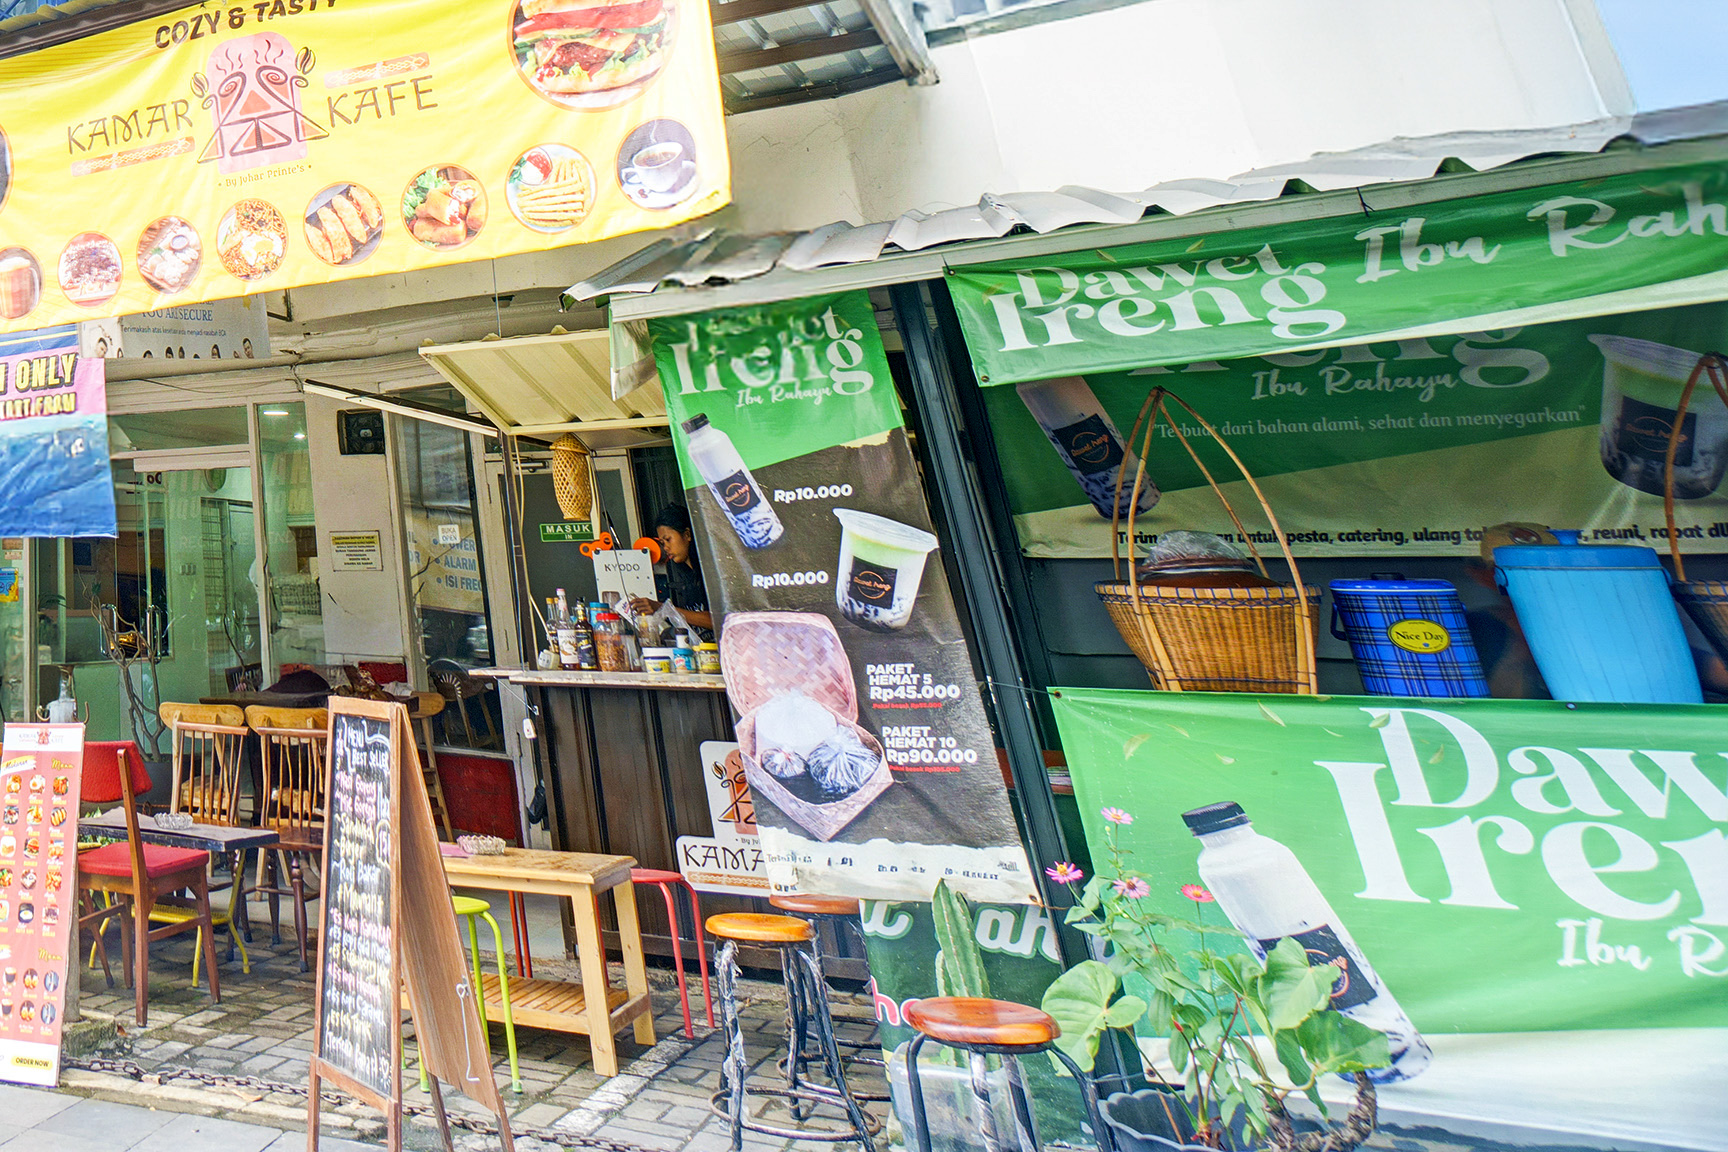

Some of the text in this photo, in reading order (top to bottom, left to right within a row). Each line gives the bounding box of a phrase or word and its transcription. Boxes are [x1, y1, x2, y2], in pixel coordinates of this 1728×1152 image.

[154, 10, 222, 49] COZY
[228, 6, 245, 30] &
[327, 75, 439, 129] KAFE
[67, 99, 194, 155] KAMAR
[226, 179, 237, 187] By
[1354, 216, 1502, 284] Ibu
[1010, 243, 1292, 309] Dawet
[179, 308, 213, 322] SECURE
[986, 262, 1347, 352] Ireng
[15, 352, 79, 393] ONLY
[1250, 362, 1460, 403] Ibu Rahayu
[735, 383, 833, 408] Ibu Rahayu
[1221, 419, 1254, 436] dari
[1257, 417, 1309, 435] bahan
[1312, 414, 1365, 434] alami,
[1368, 413, 1414, 432] sehat
[1419, 411, 1451, 429] dan
[774, 484, 853, 503] Rp10.000
[546, 523, 591, 534] MASUK
[1338, 529, 1409, 547] catering,
[1413, 528, 1460, 546] ulang
[1593, 524, 1646, 541] reuni,
[444, 555, 476, 571] ALARM
[604, 563, 640, 572] KYODO
[445, 575, 459, 588] ISI
[752, 571, 829, 589] Rp10.000
[1395, 631, 1444, 643] Nice Day
[866, 663, 915, 675] PAKET
[869, 674, 932, 685] HEMAT 5
[870, 684, 961, 701] Rp45.000
[347, 725, 364, 749] MENU
[882, 726, 931, 737] PAKET
[885, 736, 957, 748] HEMAT 10
[352, 748, 367, 766] BEST
[886, 749, 978, 765] Rp90.000
[1555, 916, 1653, 971] Ibu
[15, 1057, 34, 1066] ORDER
